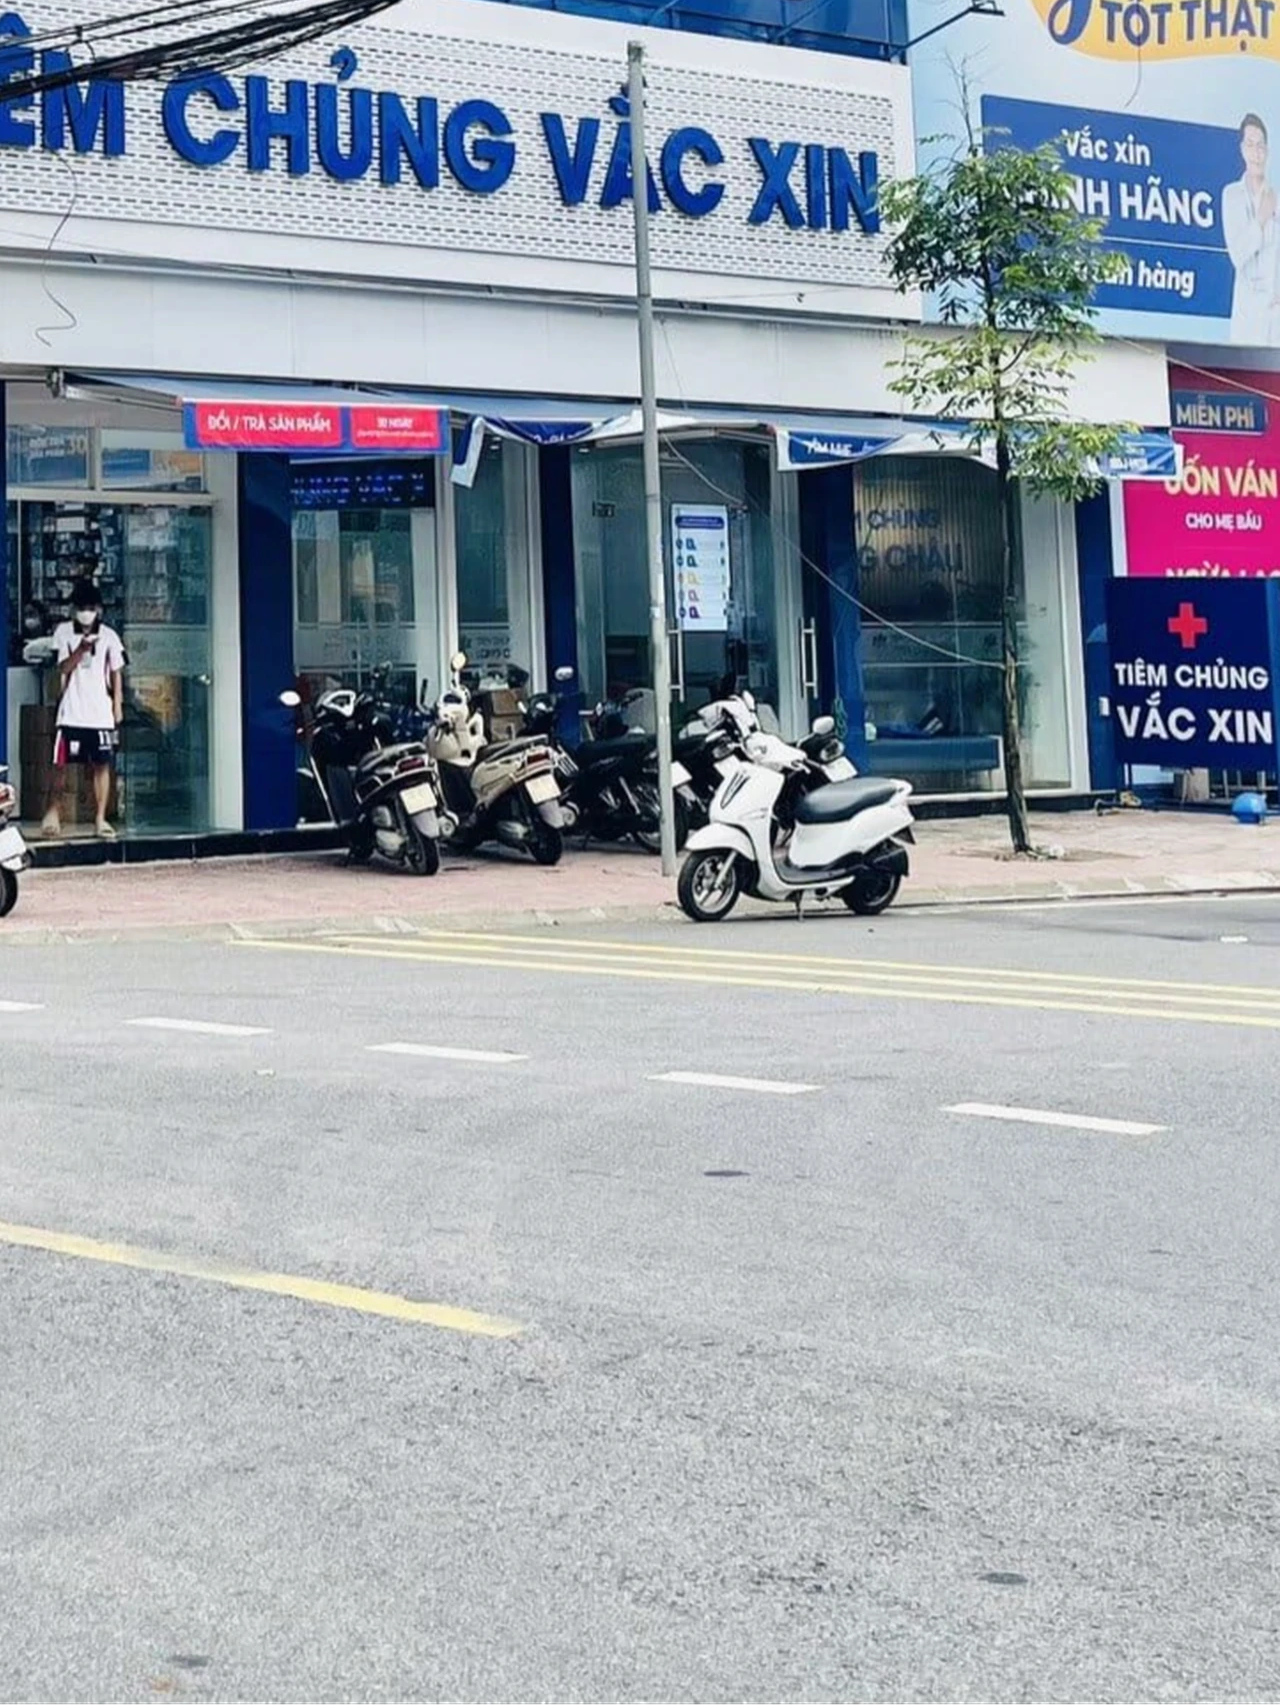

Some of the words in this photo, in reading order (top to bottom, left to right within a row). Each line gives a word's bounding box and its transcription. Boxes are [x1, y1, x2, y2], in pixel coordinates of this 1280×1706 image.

[162, 45, 517, 194] CHỦNG
[540, 79, 726, 217] VẮC
[747, 136, 882, 234] XIN
[1061, 124, 1109, 162] Vắc
[1114, 134, 1151, 167] xin
[1120, 175, 1215, 228] HÃNG
[1137, 259, 1195, 297] hàng
[1176, 394, 1221, 427] MIỄN
[1224, 401, 1256, 429] PHÍ
[1224, 459, 1279, 498] VÁN
[1185, 512, 1213, 530] CHO
[1115, 657, 1168, 687] TIÊM
[1174, 657, 1269, 690] CHỦNG
[1117, 692, 1199, 740] VẮC
[1208, 707, 1274, 744] XIN
